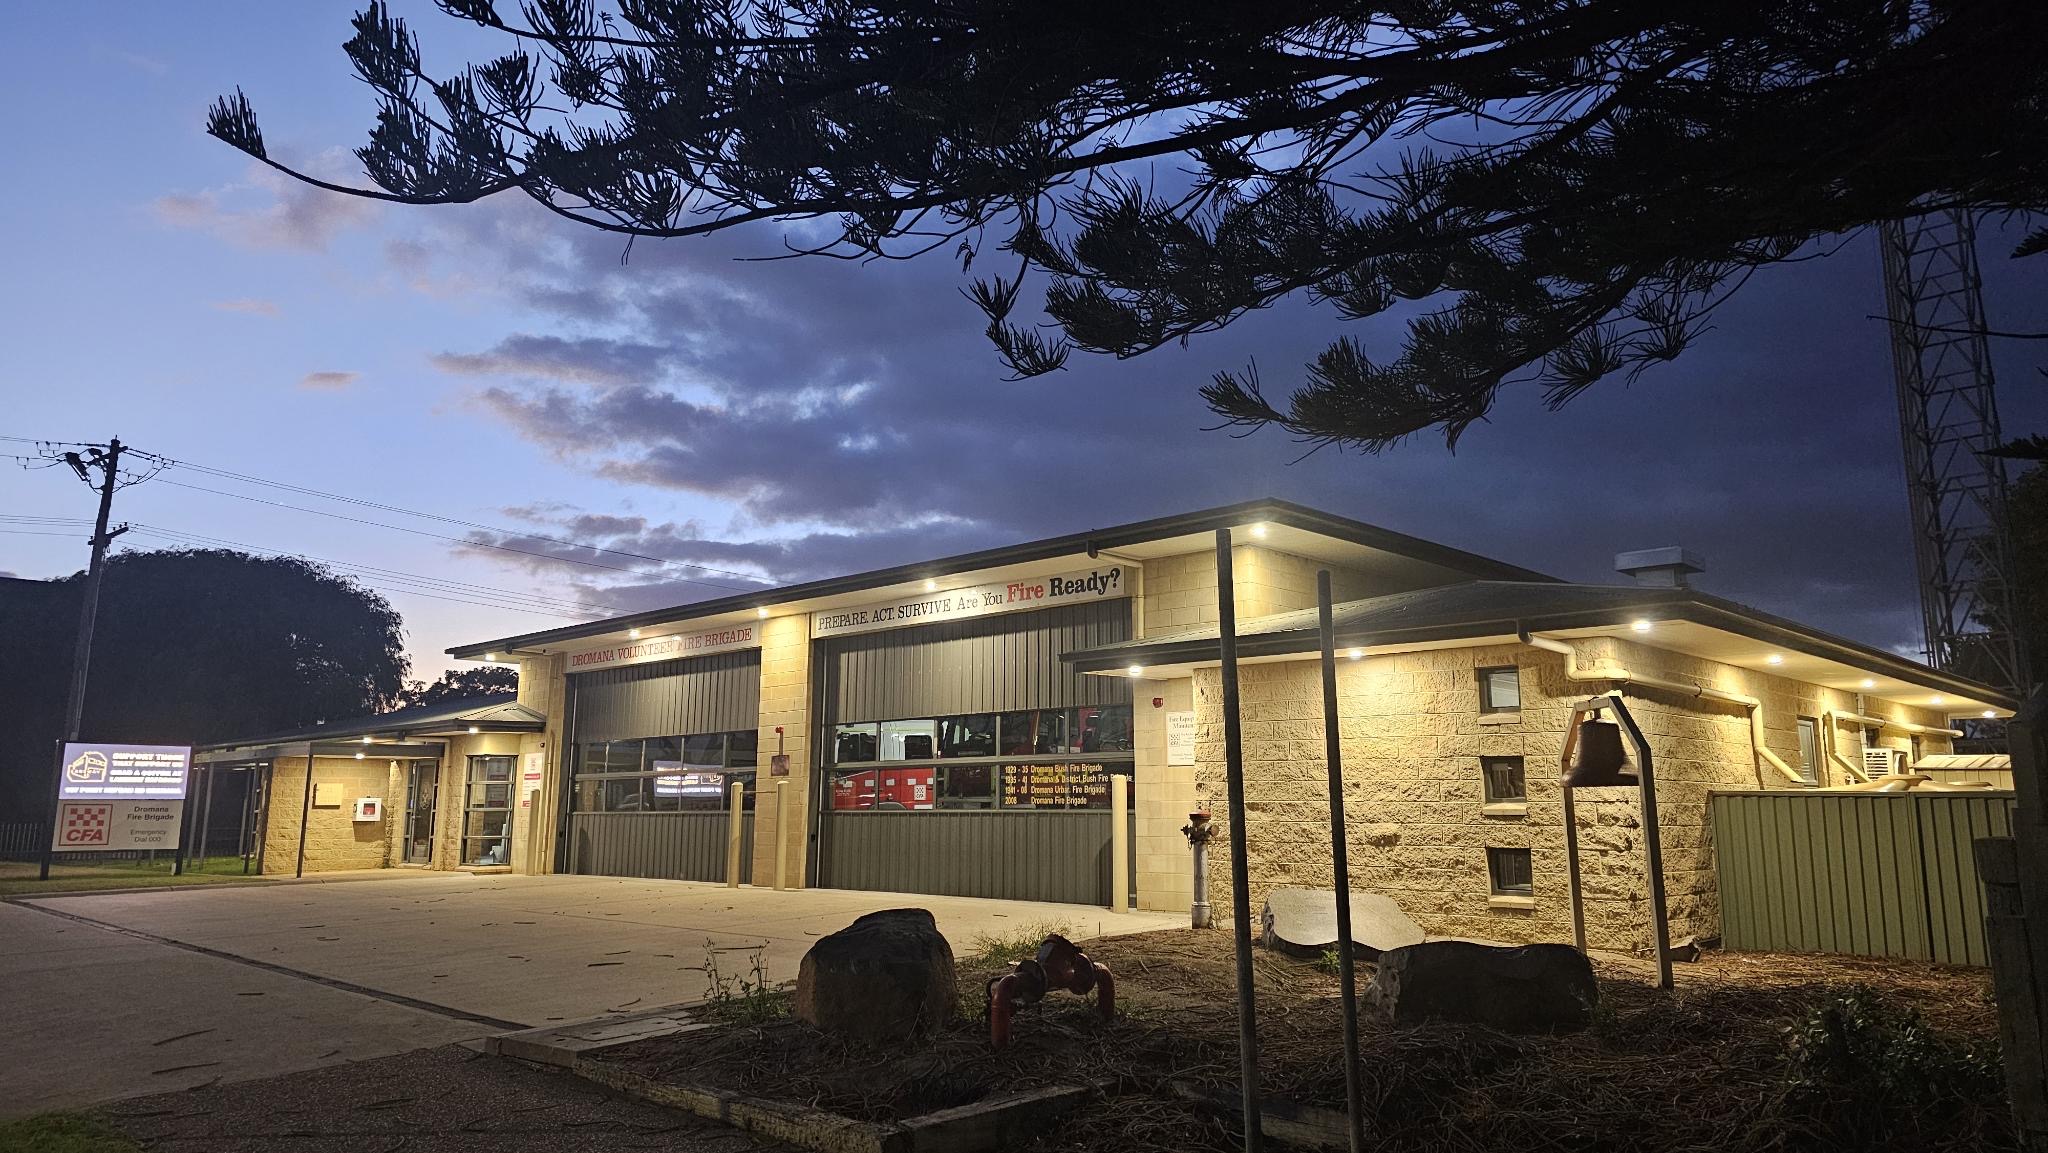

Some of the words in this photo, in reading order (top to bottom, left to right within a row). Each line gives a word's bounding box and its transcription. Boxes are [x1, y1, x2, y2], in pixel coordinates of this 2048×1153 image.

[897, 599, 951, 619] SURVIVE
[956, 596, 978, 610] Are
[983, 591, 1003, 607] You
[1006, 582, 1044, 603] Fire
[1049, 567, 1121, 597] Ready?
[572, 652, 615, 667] DROMANA
[617, 640, 673, 659] VOLUNTEER
[677, 635, 702, 651] FIRE
[704, 627, 752, 647] BRIGADE
[1030, 765, 1054, 774] Dromana
[1069, 764, 1080, 773] Fire
[1081, 763, 1103, 774] Brigade
[1083, 774, 1097, 783] Bush
[1098, 774, 1109, 783] Fire
[1030, 786, 1054, 794] Dromana
[1072, 785, 1082, 794] Fire
[1084, 785, 1105, 795] Brigade
[1030, 796, 1054, 805] Dromana
[1054, 796, 1065, 805] Fire
[1066, 795, 1087, 807] Brigade
[66, 829, 103, 842] CFA
